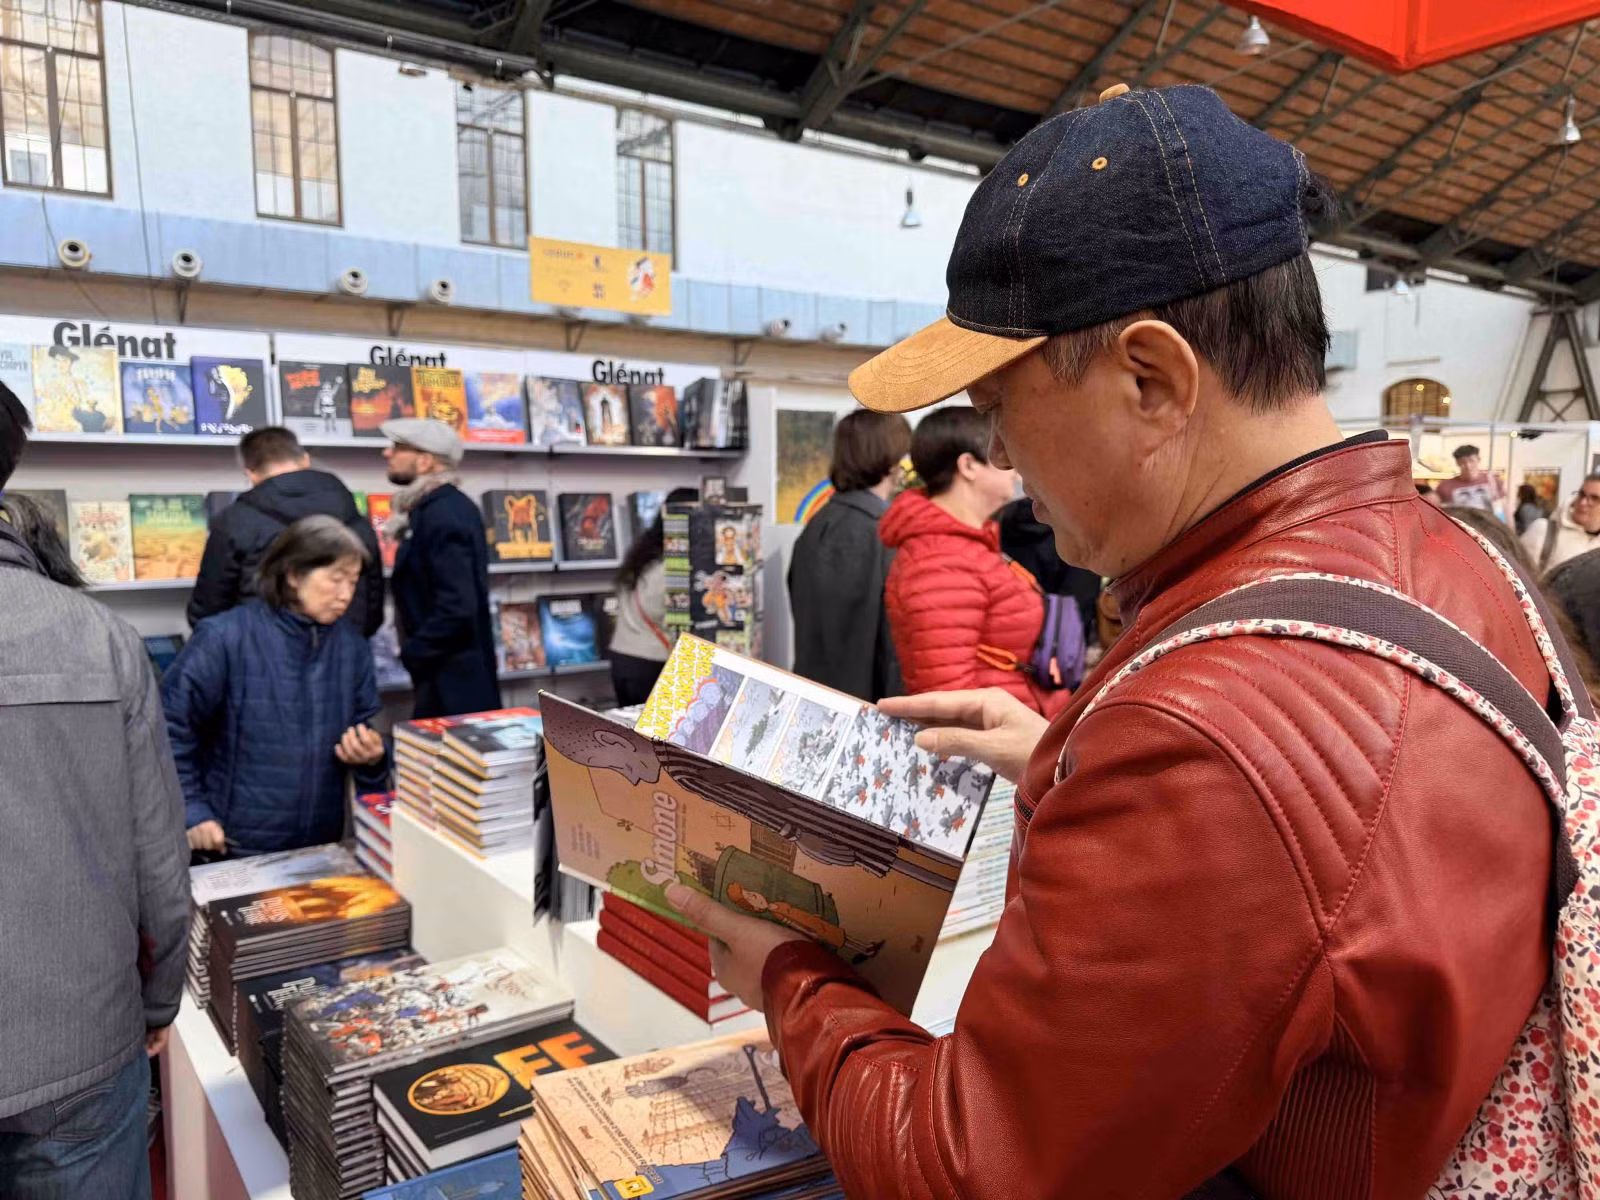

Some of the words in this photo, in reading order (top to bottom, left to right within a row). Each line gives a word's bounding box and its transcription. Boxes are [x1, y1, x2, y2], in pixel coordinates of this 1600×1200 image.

[53, 321, 177, 359] Glénat
[370, 345, 447, 368] Glénat
[592, 359, 665, 386] Glénat
[640, 791, 679, 887] Simone
